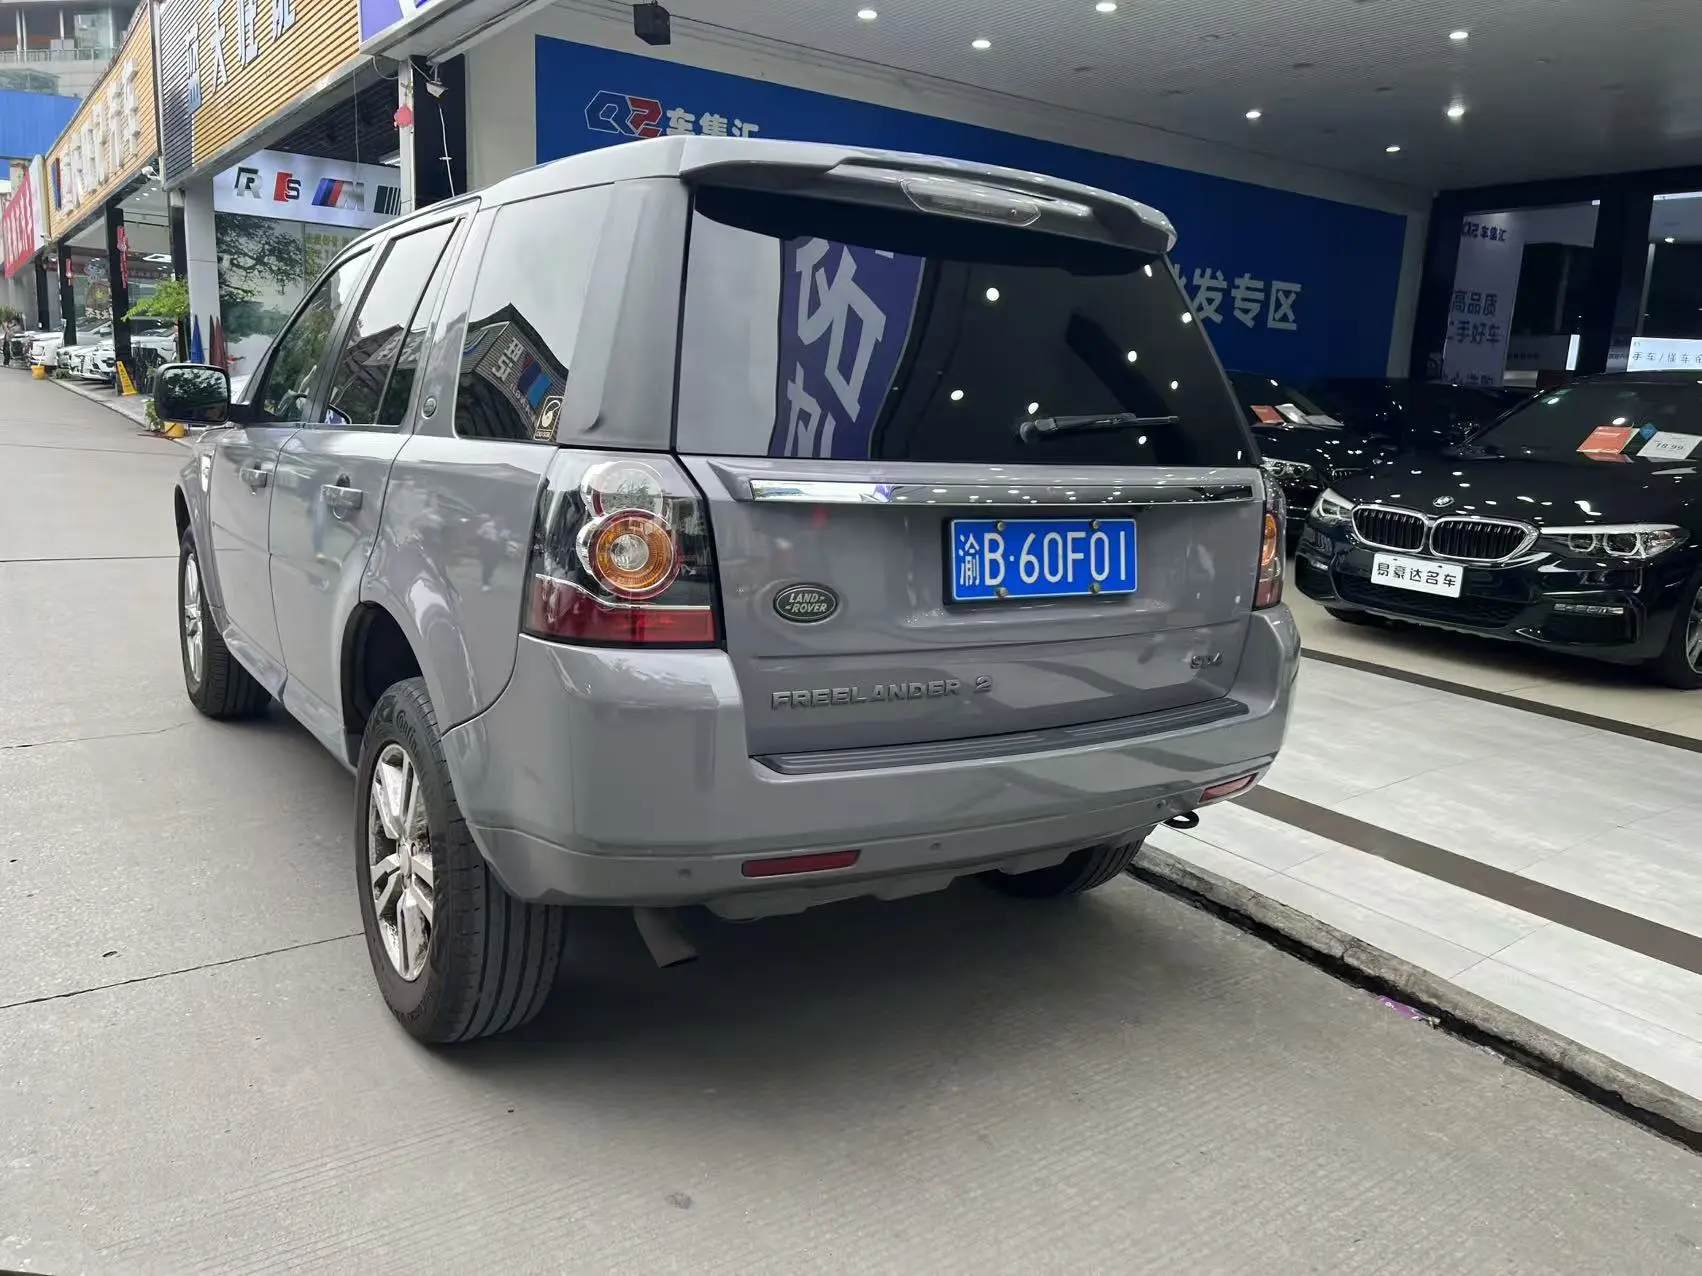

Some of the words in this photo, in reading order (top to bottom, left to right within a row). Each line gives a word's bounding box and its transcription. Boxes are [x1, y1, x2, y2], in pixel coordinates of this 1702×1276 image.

[235, 167, 263, 199] R
[1174, 264, 1302, 331] 发专区
[1452, 290, 1498, 317] 高品质
[959, 531, 1126, 587] 渝B·60F01
[1377, 562, 1457, 588] 易豪达名车
[788, 593, 819, 603] LAND
[791, 603, 828, 613] ROVER
[772, 678, 962, 710] FREELANDER
[974, 674, 994, 694] 2
